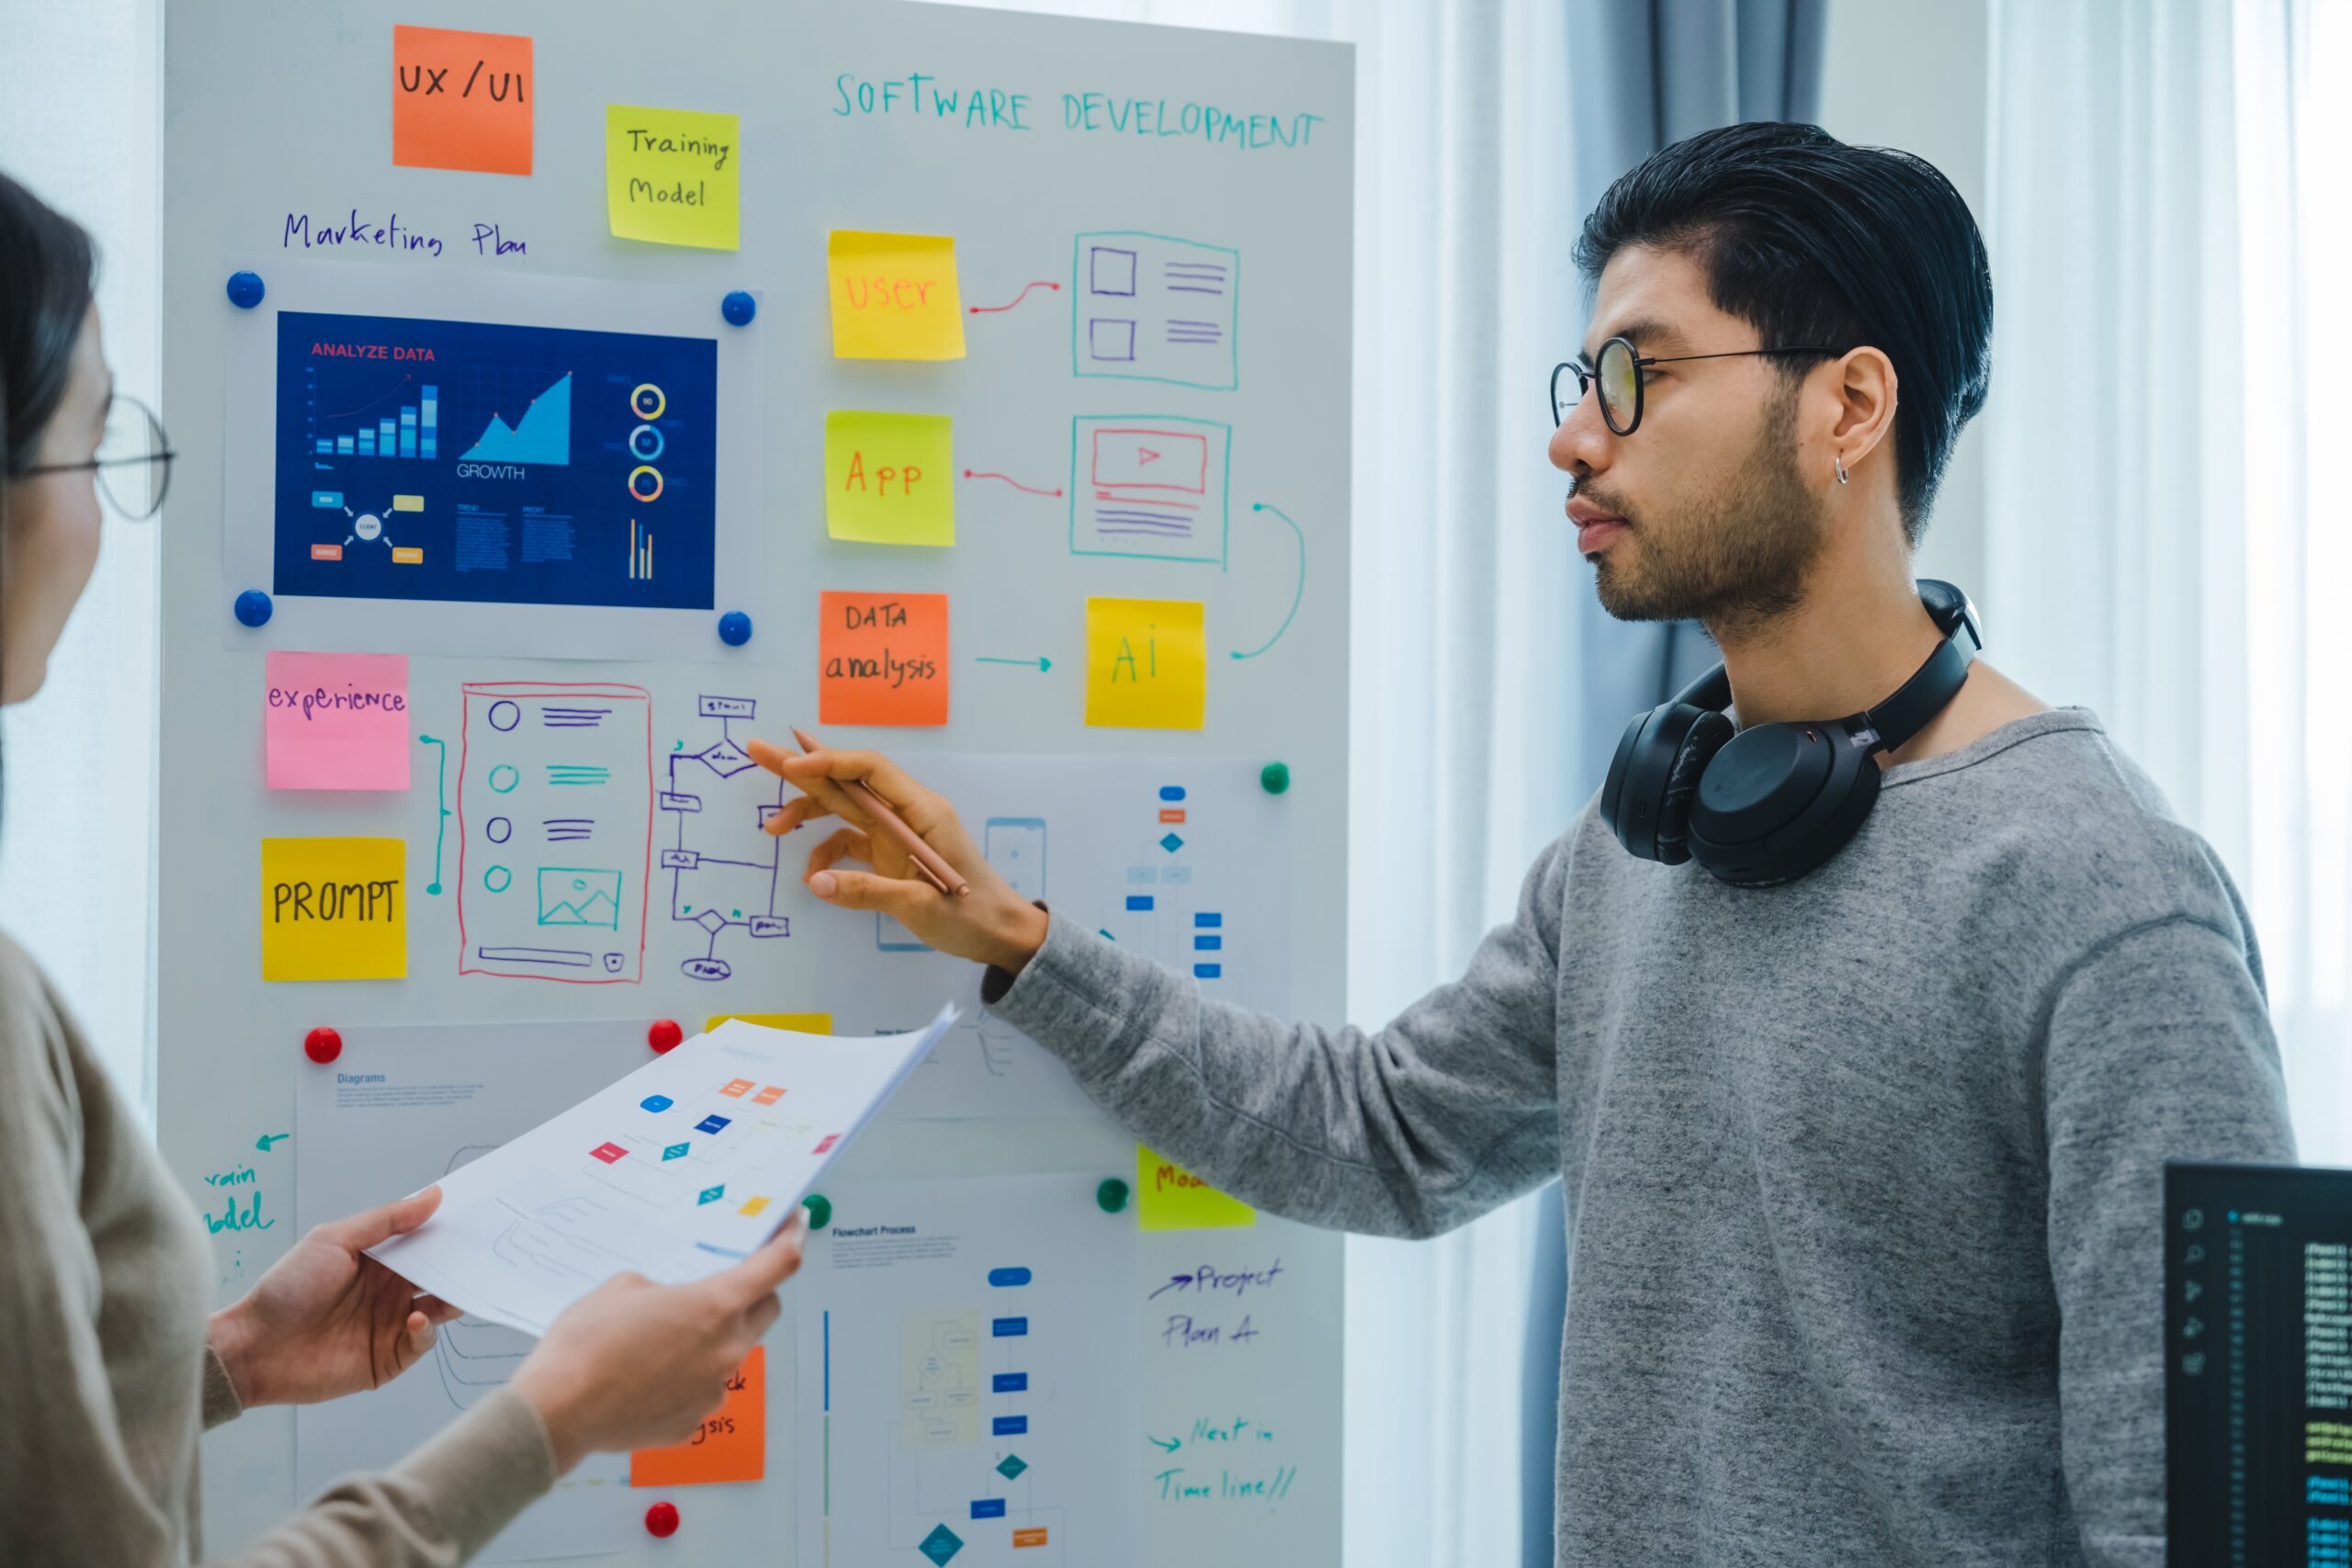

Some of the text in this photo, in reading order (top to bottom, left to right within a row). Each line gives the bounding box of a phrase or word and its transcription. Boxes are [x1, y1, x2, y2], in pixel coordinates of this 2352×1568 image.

[832, 72, 1325, 151] SOFTWARE DEVELOPMENT
[627, 129, 730, 171] Training
[628, 176, 705, 207] Model
[283, 209, 527, 257] Marketing Plan
[311, 342, 435, 362] ANALYZE DATA
[457, 462, 526, 479] GROWTH
[845, 449, 923, 497] App
[845, 603, 909, 630] DATA
[825, 647, 937, 689] analysis
[267, 682, 406, 721] experience
[274, 879, 400, 924] PROMPT
[337, 1073, 387, 1086] Diagrams
[832, 1224, 916, 1237] Flowchart Process
[1196, 1257, 1284, 1296] Project
[1162, 1314, 1261, 1348] Plan A
[692, 1416, 736, 1445] ysis
[1190, 1416, 1273, 1444] Next in
